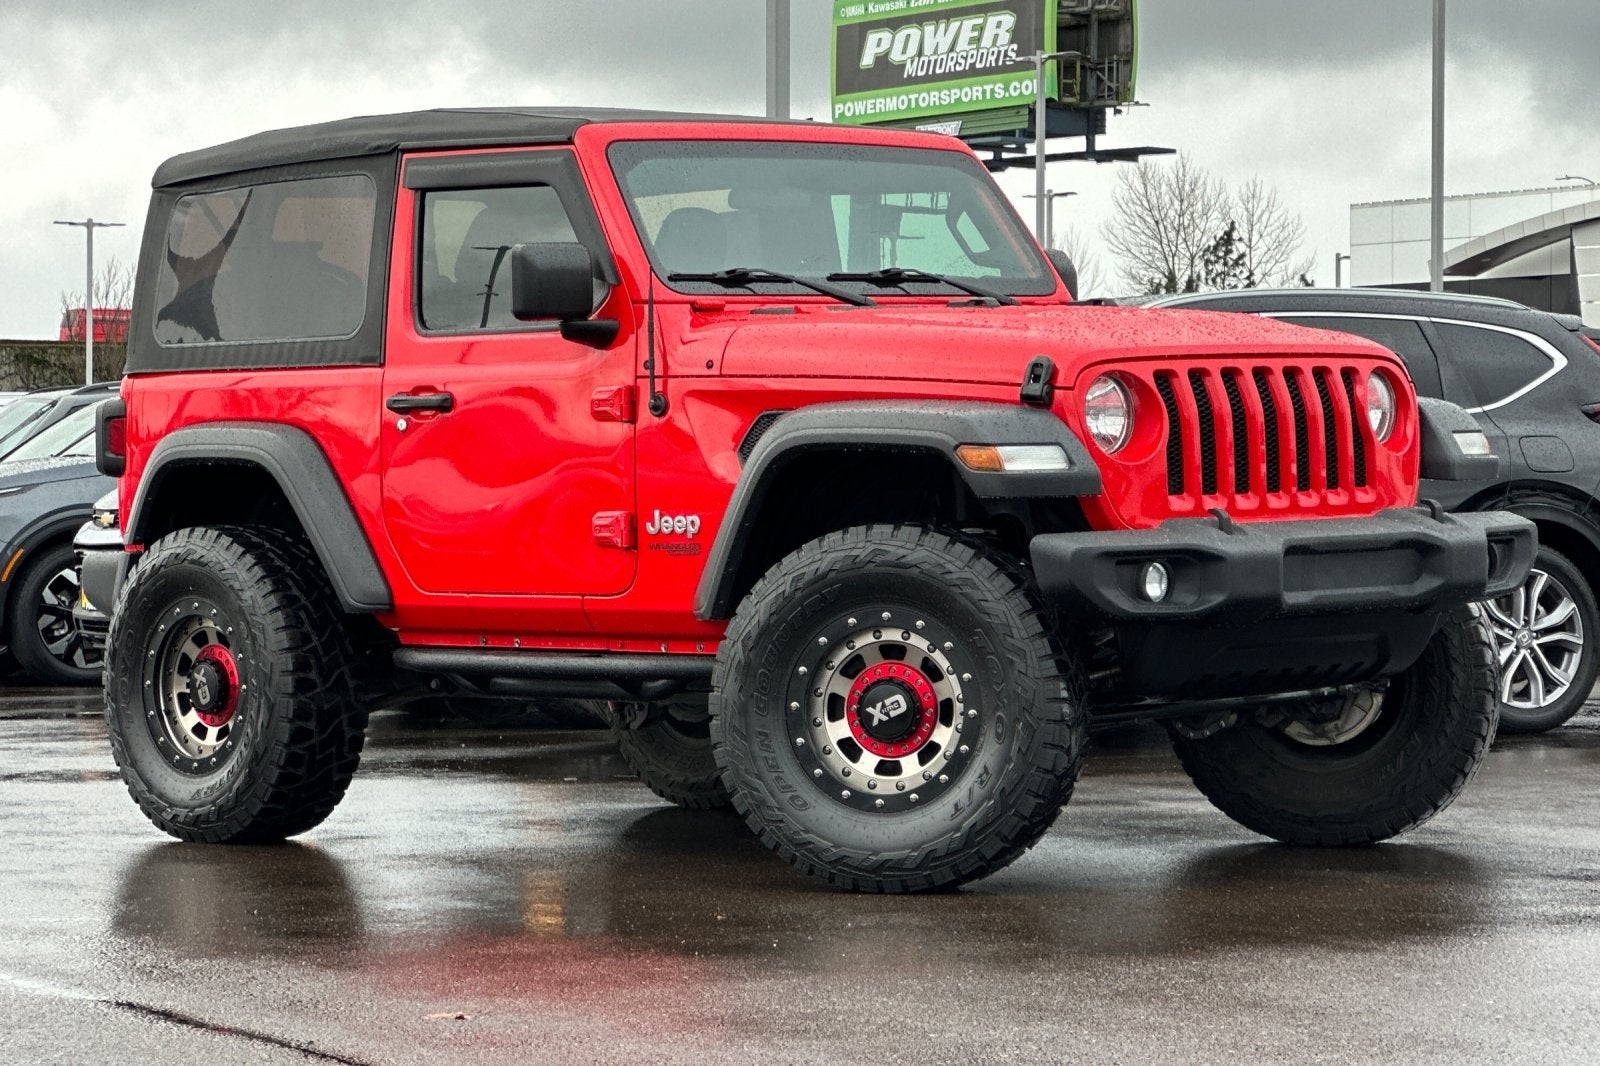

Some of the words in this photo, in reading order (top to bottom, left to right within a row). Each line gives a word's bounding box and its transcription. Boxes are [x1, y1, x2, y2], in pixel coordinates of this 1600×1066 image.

[868, 0, 906, 14] Kawasaki
[861, 11, 1016, 68] POWER
[904, 43, 1018, 79] MOTORSPORTS
[646, 509, 700, 538] Jeep
[865, 694, 907, 727] XD
[755, 727, 810, 811] OPEN
